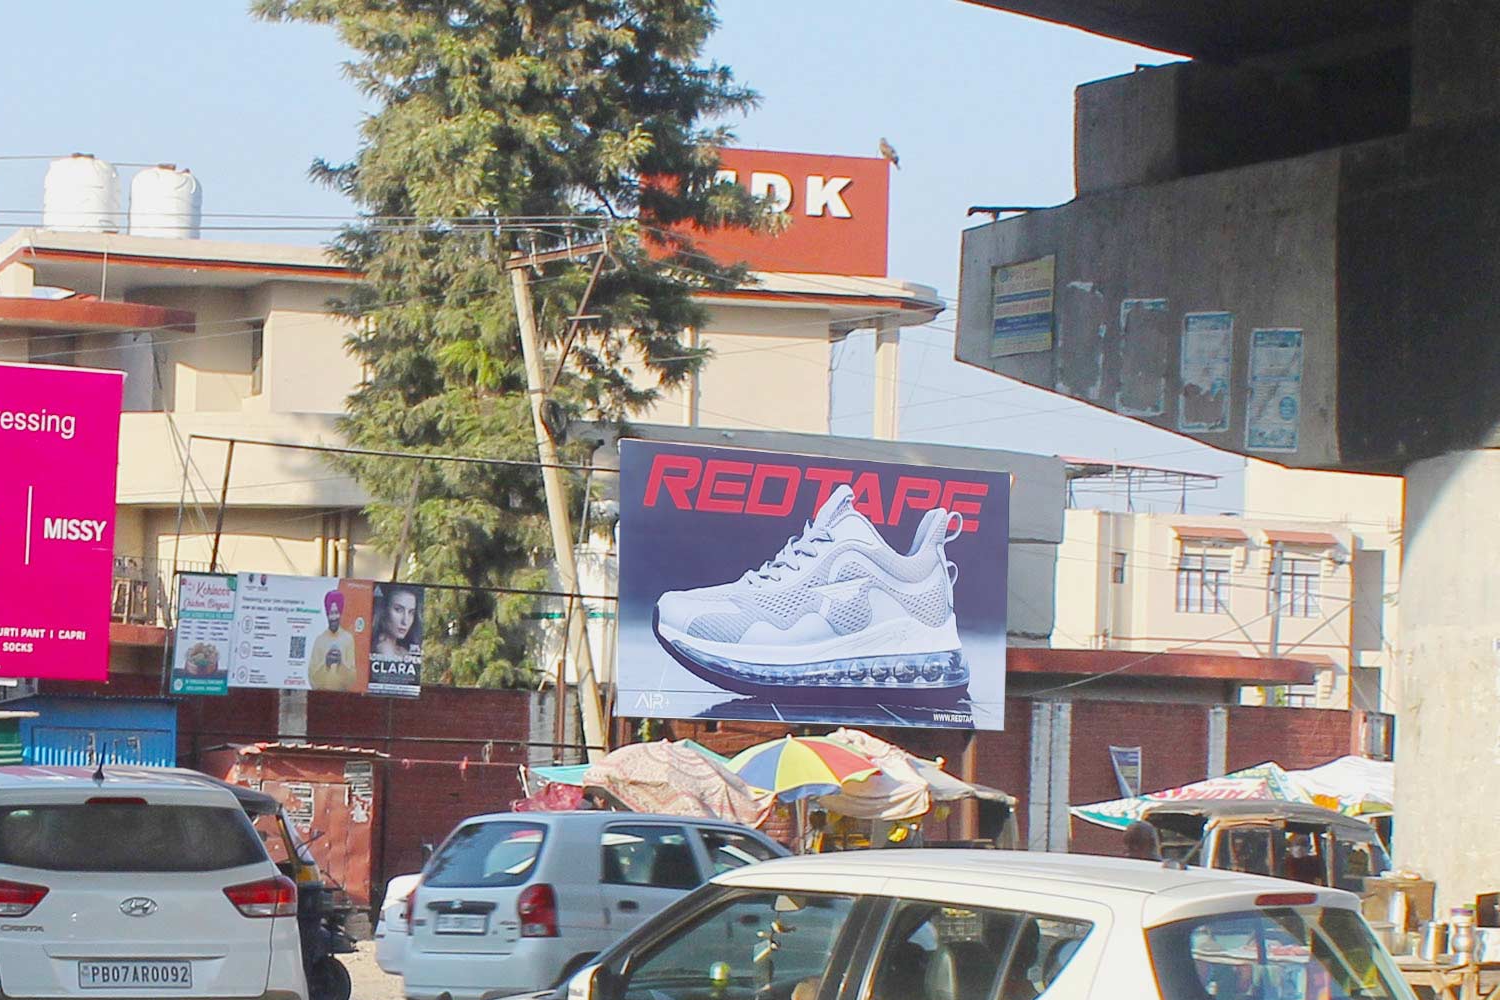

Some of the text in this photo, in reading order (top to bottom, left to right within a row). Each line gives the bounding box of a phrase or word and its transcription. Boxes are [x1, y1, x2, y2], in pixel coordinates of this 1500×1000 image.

[43, 517, 108, 542] MISSY
[21, 627, 46, 639] PANT
[58, 629, 86, 641] CAPRI
[3, 641, 34, 653] SOCKS
[371, 661, 417, 676] CLARA
[91, 966, 189, 982] PB07AR0092
